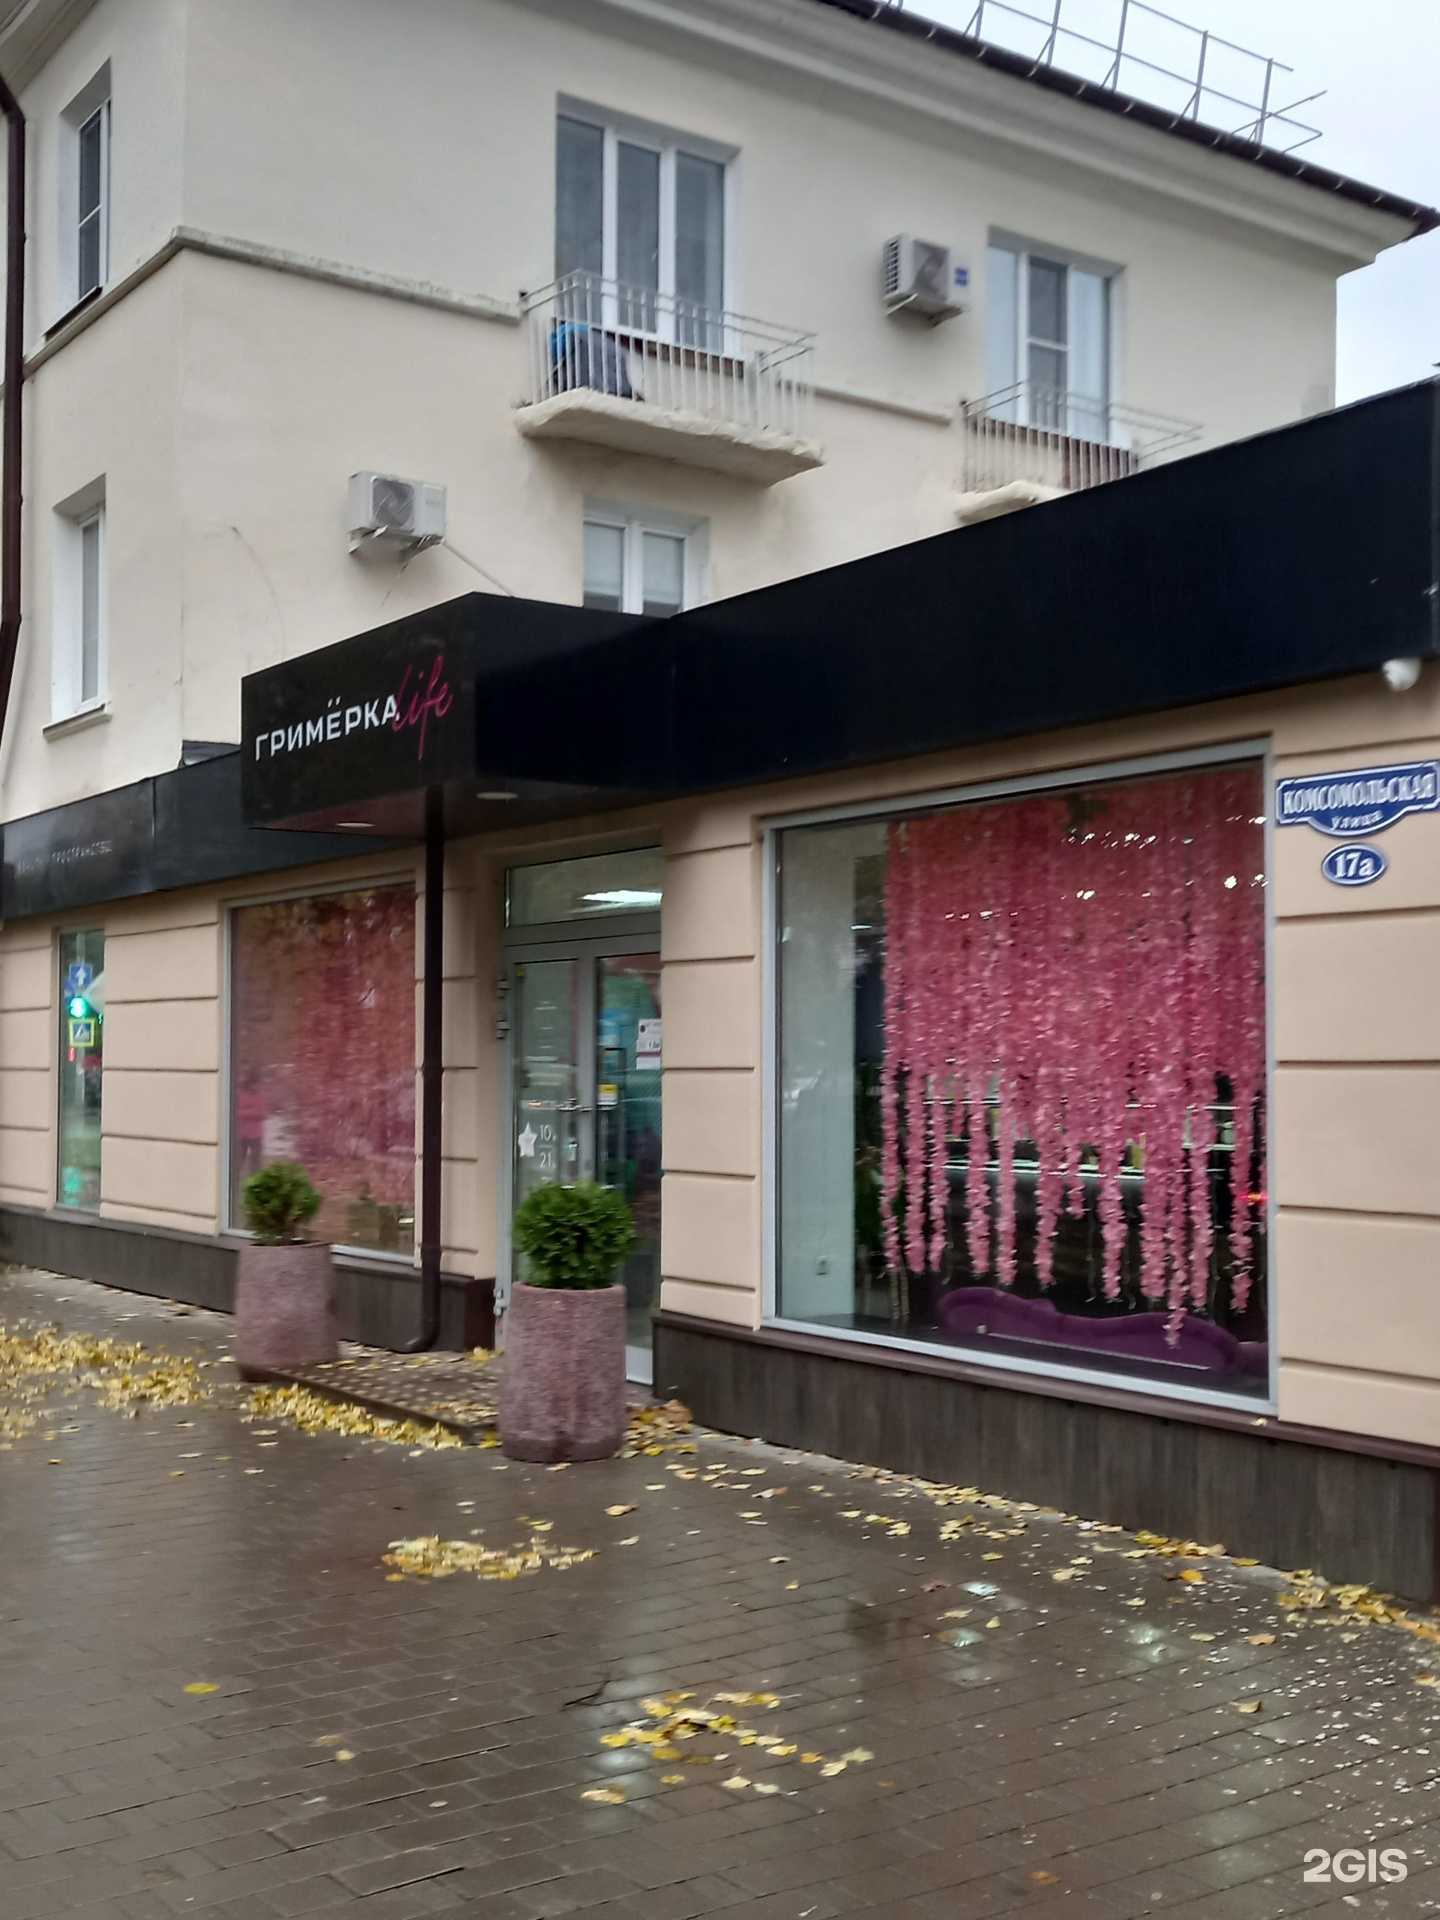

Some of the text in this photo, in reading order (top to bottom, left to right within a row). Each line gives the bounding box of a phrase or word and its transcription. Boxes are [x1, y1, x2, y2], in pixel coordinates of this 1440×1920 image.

[255, 654, 454, 762] ГРИМЁРКА life
[1283, 772, 1436, 815] КОМСОМОЛЬСКАЯ
[1334, 851, 1376, 879] 17а
